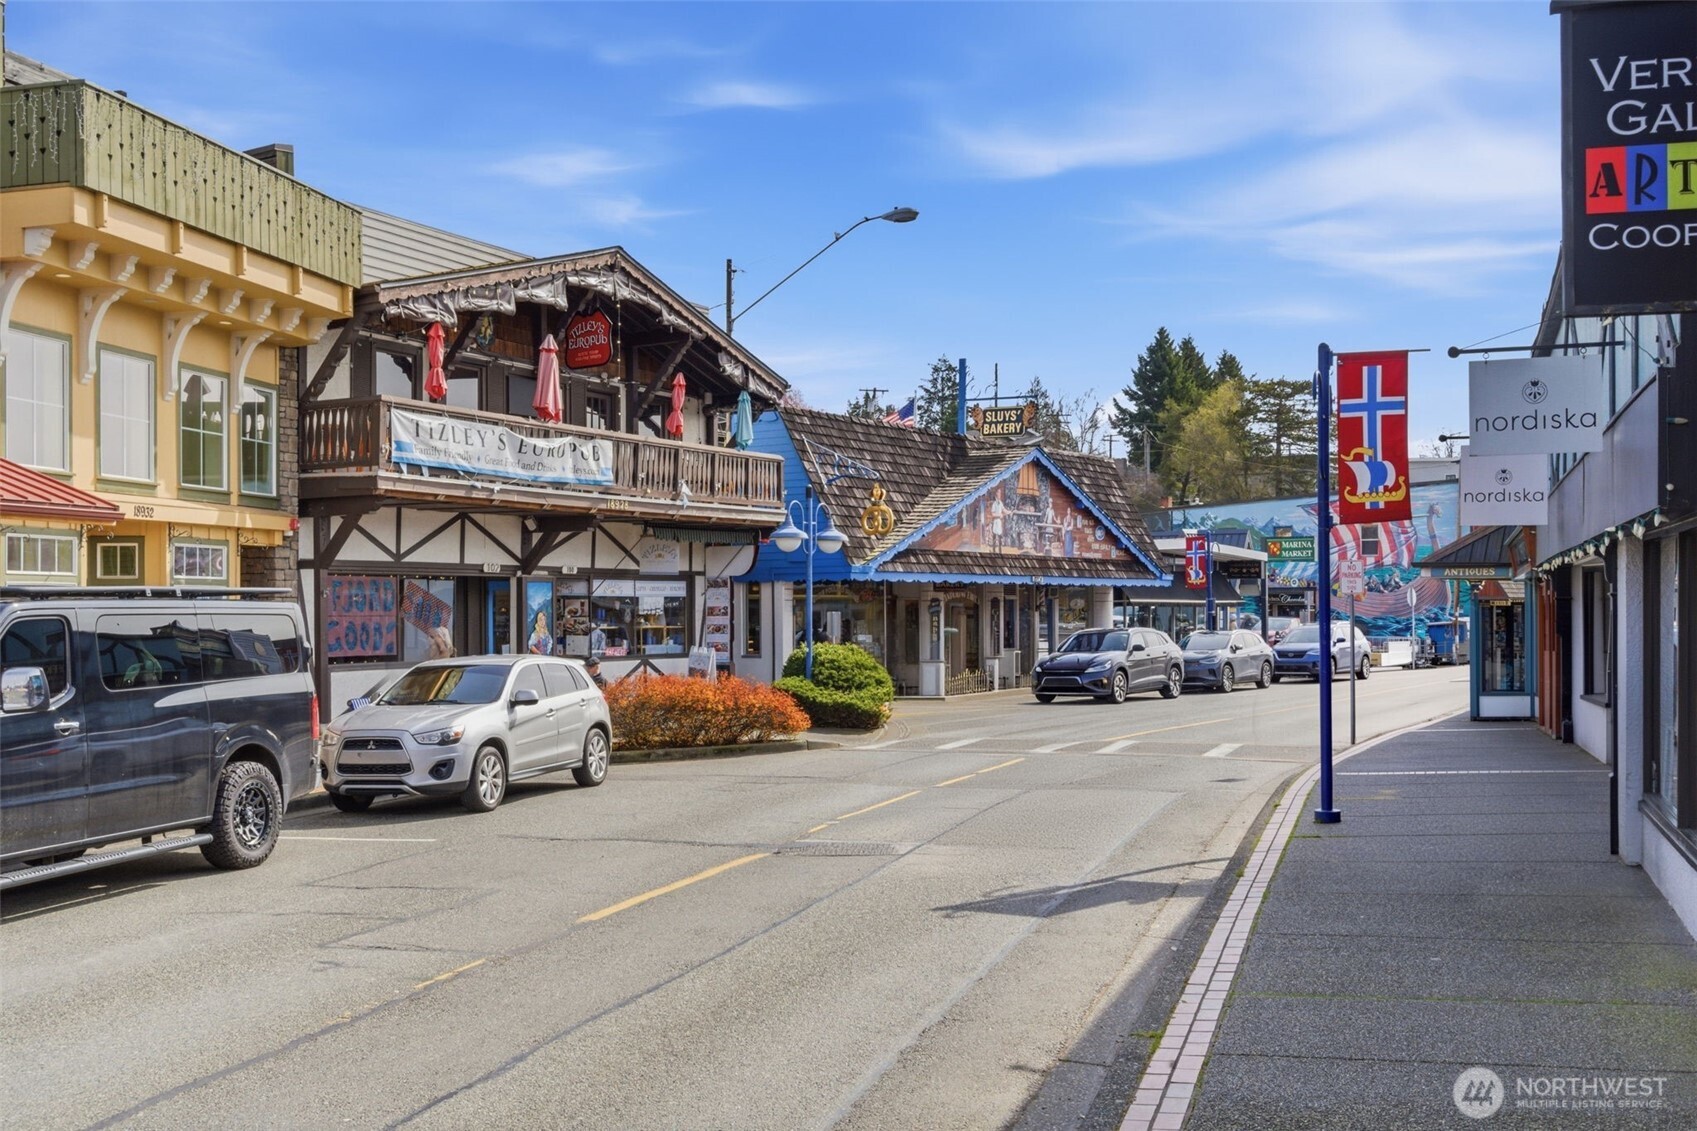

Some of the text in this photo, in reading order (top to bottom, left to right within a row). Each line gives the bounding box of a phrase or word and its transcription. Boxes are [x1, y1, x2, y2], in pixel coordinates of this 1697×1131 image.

[1589, 56, 1697, 92] VER
[985, 410, 1021, 422] SLUYS'
[1475, 408, 1597, 432] nordiska
[983, 422, 1022, 434] BAKERY
[1464, 488, 1545, 503] nordiska
[133, 505, 155, 518] 18932
[1281, 550, 1312, 558] MARKET
[1444, 567, 1496, 577] ANTIQUES
